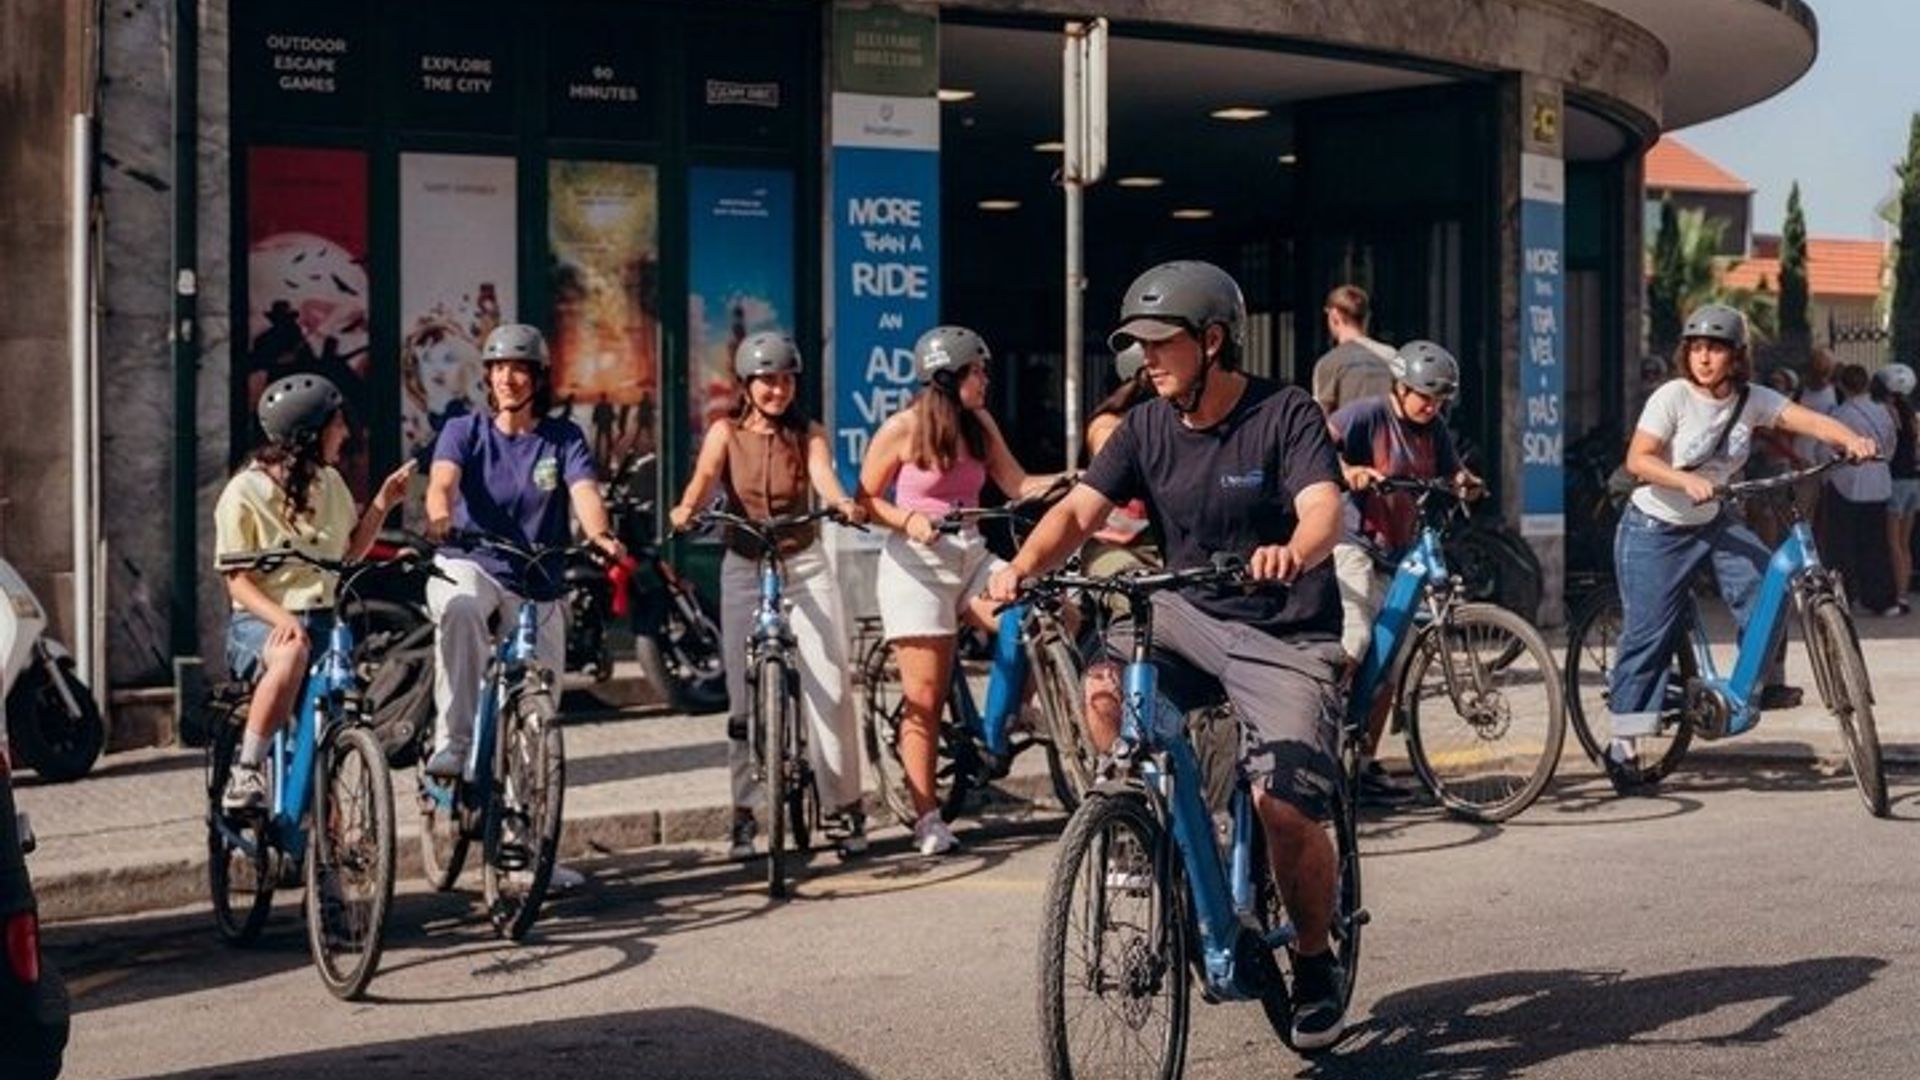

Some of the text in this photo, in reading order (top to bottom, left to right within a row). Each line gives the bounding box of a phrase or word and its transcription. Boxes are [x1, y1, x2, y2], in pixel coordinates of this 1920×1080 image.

[266, 34, 347, 53] OUTDOOR
[274, 55, 336, 73] ESCAPE
[421, 56, 492, 74] EXPLORE
[279, 75, 336, 93] GAMES
[423, 75, 492, 94] THE CITY
[569, 84, 638, 102] MINUTES
[848, 198, 922, 227] MORE
[861, 230, 922, 254] THAN A
[852, 262, 928, 299] RIDE
[878, 312, 903, 330] AN
[866, 346, 917, 384] AD
